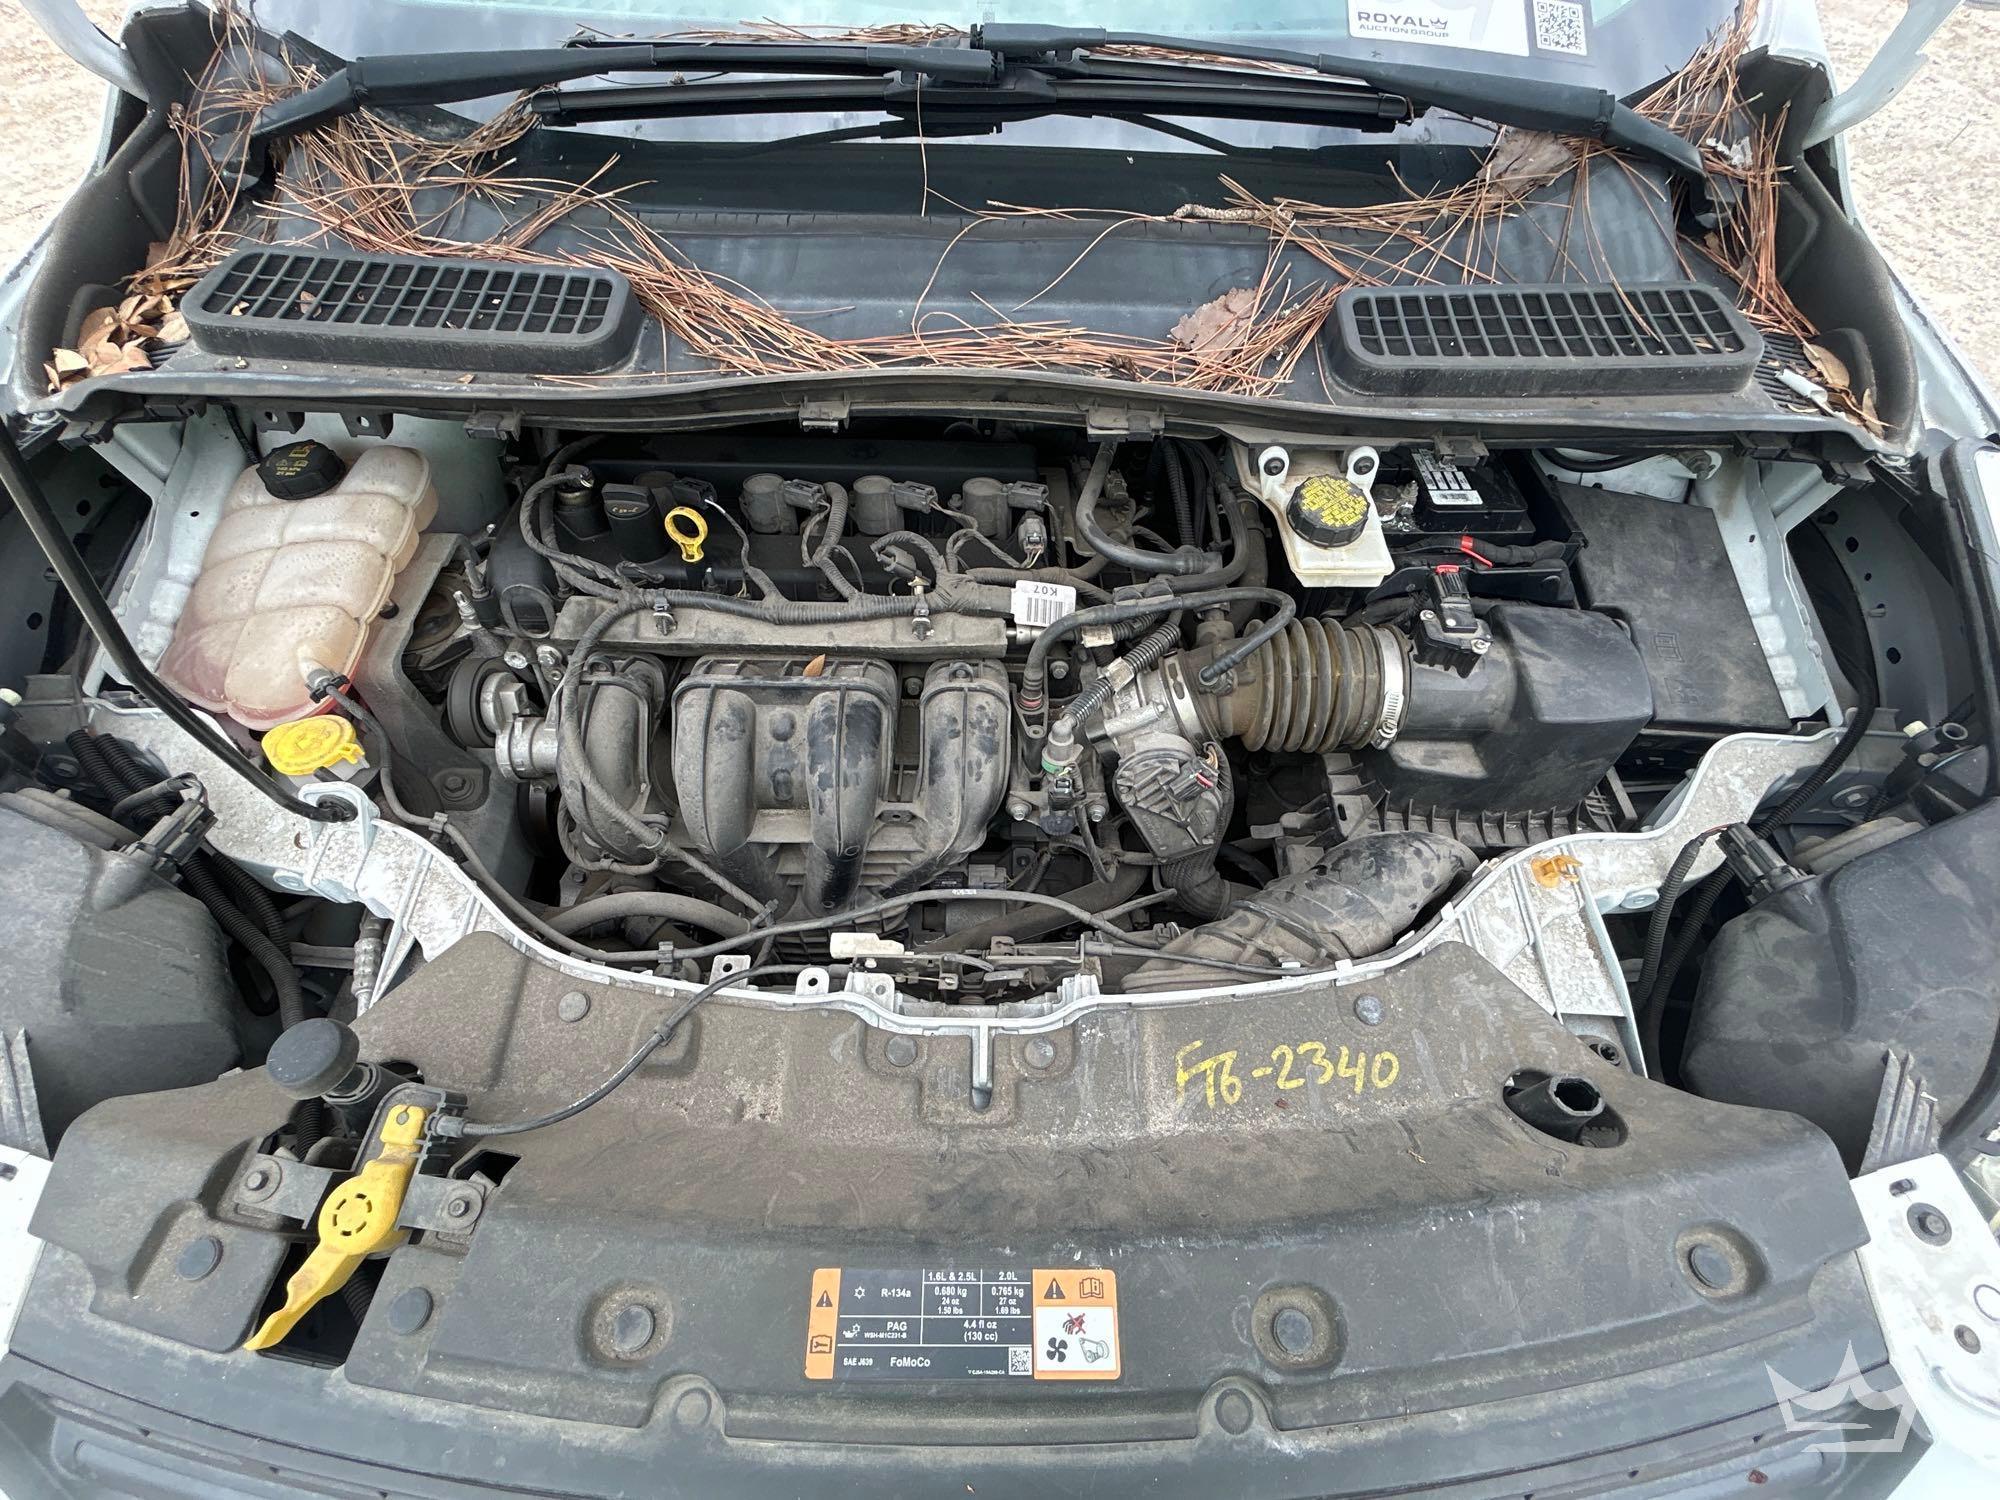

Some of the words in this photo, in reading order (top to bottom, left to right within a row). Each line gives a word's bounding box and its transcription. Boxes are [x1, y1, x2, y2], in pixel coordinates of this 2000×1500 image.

[1358, 11, 1430, 28] ROYAL
[1359, 24, 1409, 35] AUCTION
[1410, 28, 1449, 38] GROUP
[1034, 585, 1058, 596] K07
[928, 1272, 947, 1281] 1.6L
[949, 1272, 956, 1281] &
[958, 1272, 977, 1281] 2.5L
[998, 1272, 1018, 1281] 2.0L
[881, 1289, 911, 1298] R-134a
[934, 1286, 956, 1296] 0.680
[957, 1286, 967, 1298] kg
[991, 1286, 1013, 1296] 0.765
[1014, 1286, 1024, 1298] kg
[999, 1297, 1007, 1305] 27
[886, 1321, 908, 1331] PAG
[963, 1320, 976, 1330] 4.4
[978, 1320, 985, 1330] fl
[987, 1322, 997, 1330] oz
[963, 1331, 982, 1342] (130
[984, 1331, 998, 1342] cc)
[843, 1357, 857, 1367] SAE
[890, 1356, 931, 1368] FoMoCo
